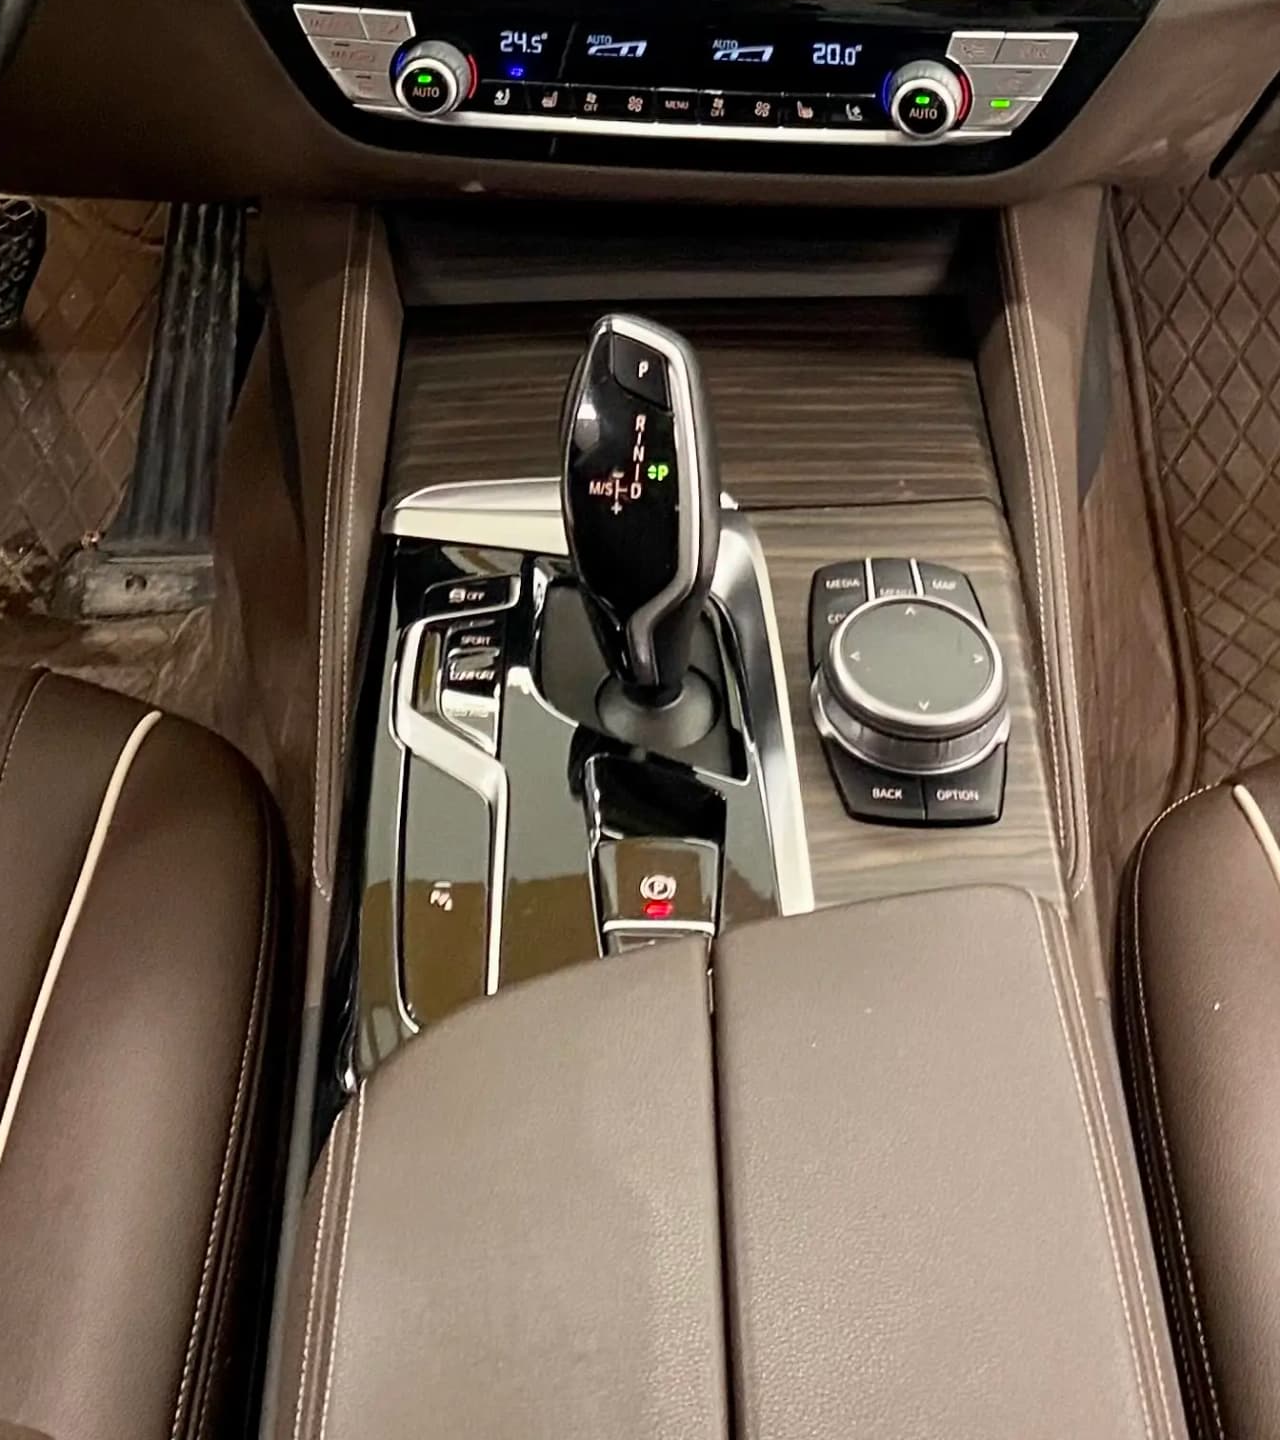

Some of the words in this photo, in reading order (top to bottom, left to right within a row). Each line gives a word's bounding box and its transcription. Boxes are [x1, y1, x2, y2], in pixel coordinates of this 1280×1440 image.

[586, 35, 612, 46] AUTO
[712, 39, 738, 50] AUTO
[412, 86, 440, 99] AUTO
[665, 100, 690, 110] MENU
[909, 108, 938, 120] AUTO
[638, 360, 649, 378] P
[635, 415, 646, 432] R
[633, 446, 644, 462] N
[658, 465, 669, 481] P
[589, 480, 613, 496] M/S
[630, 483, 642, 499] D
[826, 579, 860, 589] MEDIA
[932, 579, 956, 590] MAP
[872, 788, 902, 800] BACK
[936, 789, 979, 801] OPTION
